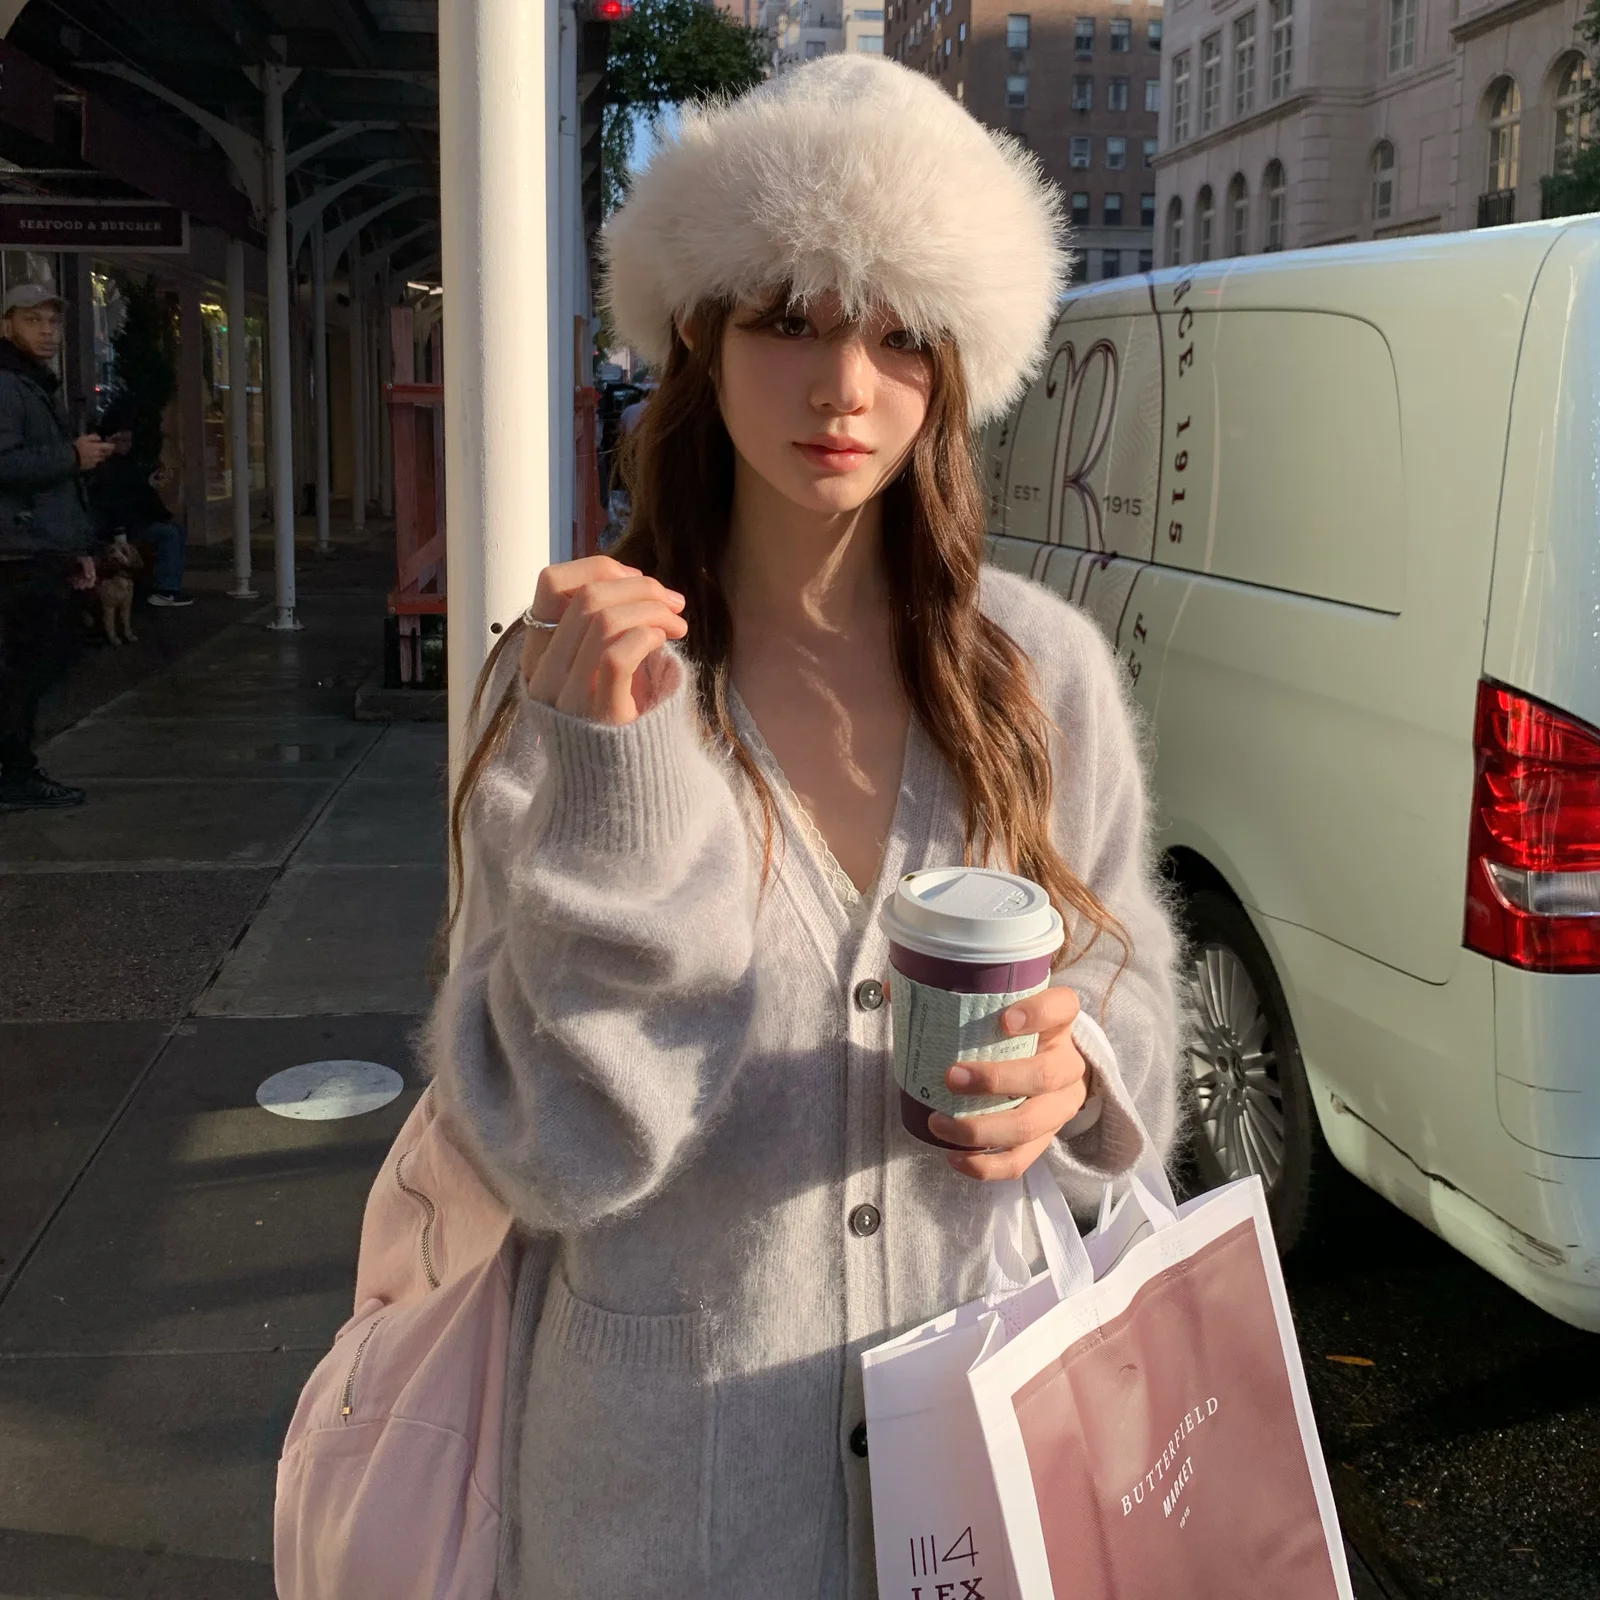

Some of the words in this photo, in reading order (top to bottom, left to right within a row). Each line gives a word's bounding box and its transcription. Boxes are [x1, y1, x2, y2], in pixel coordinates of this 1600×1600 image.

[19, 219, 84, 231] SEAFOOD
[87, 220, 97, 231] &
[101, 221, 163, 232] BUTCHER
[1102, 495, 1143, 517] 1915
[1169, 415, 1191, 544] 1915
[1120, 1396, 1218, 1516] BUTTERFIELD
[1162, 1456, 1194, 1518] MARKET
